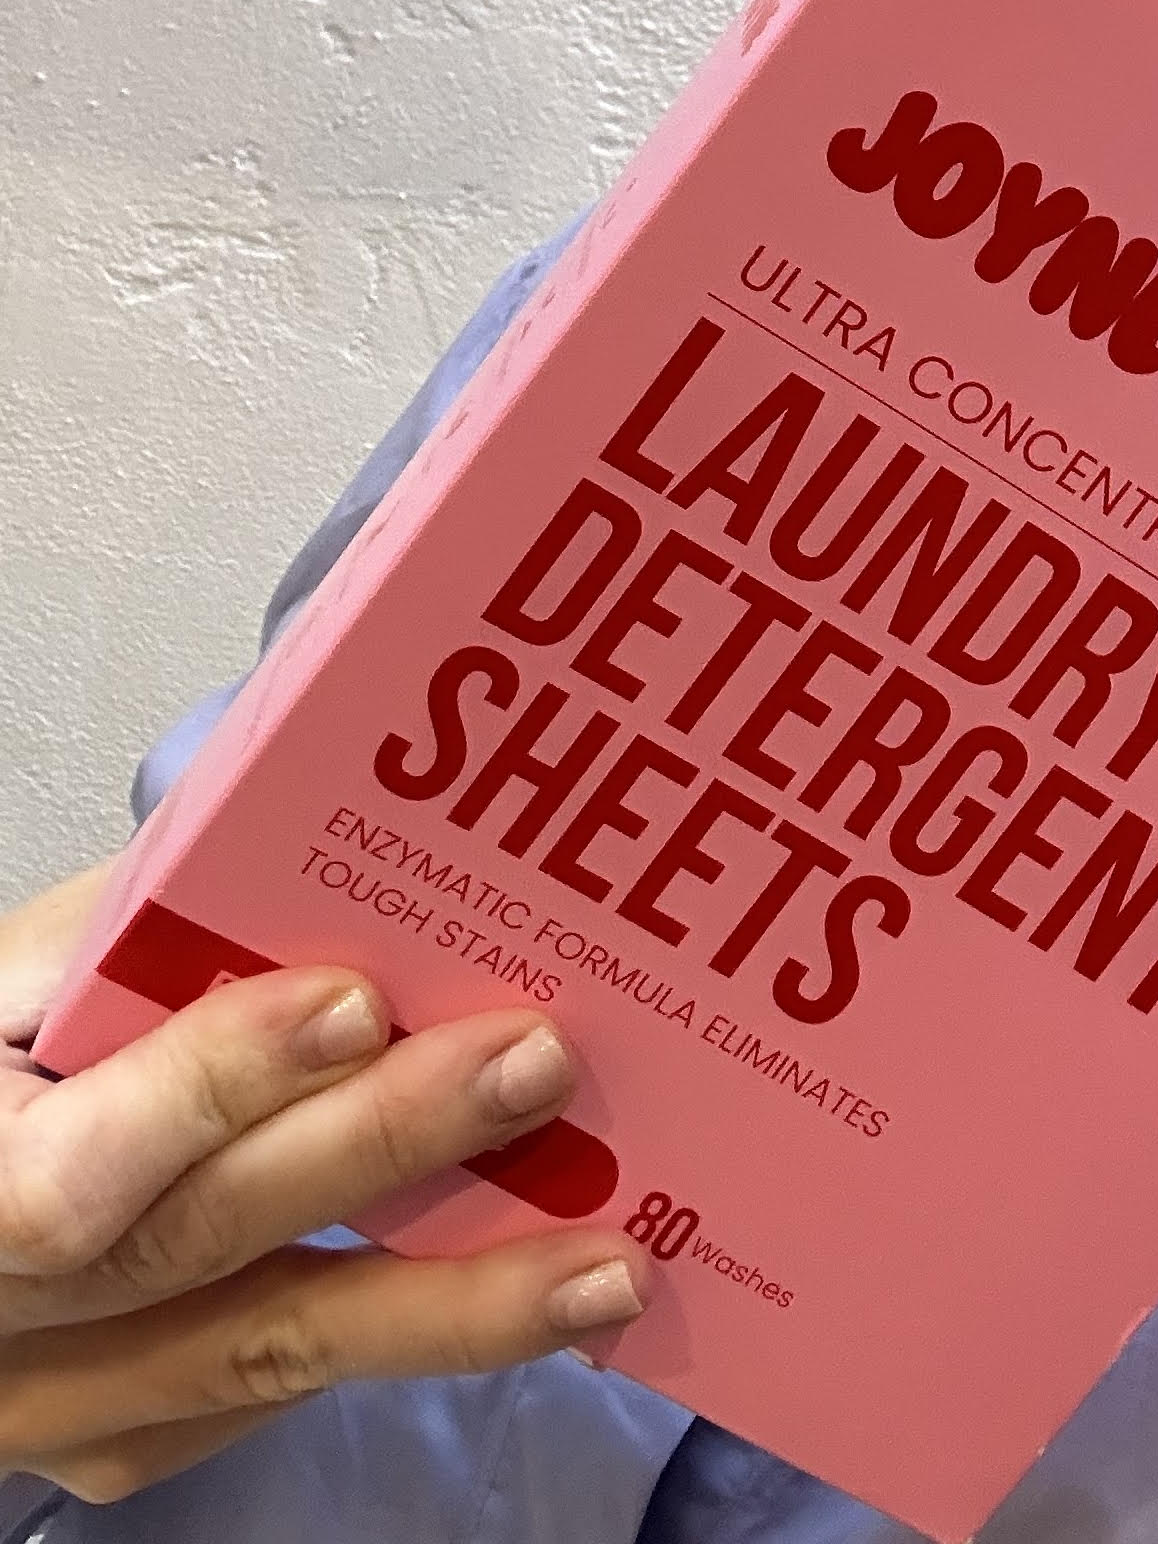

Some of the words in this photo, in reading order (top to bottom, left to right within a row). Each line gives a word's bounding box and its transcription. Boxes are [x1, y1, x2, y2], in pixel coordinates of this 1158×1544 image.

[741, 245, 897, 373] ULTRA
[373, 645, 912, 1026] SHEETS
[300, 845, 435, 934] TOUGH
[435, 919, 563, 1003] STAINS
[323, 806, 532, 934] ENZYMATIC
[533, 918, 696, 1030] FORMULA
[699, 1014, 890, 1138] ELIMINATES
[623, 1190, 701, 1262] 80
[691, 1234, 796, 1309] washes
